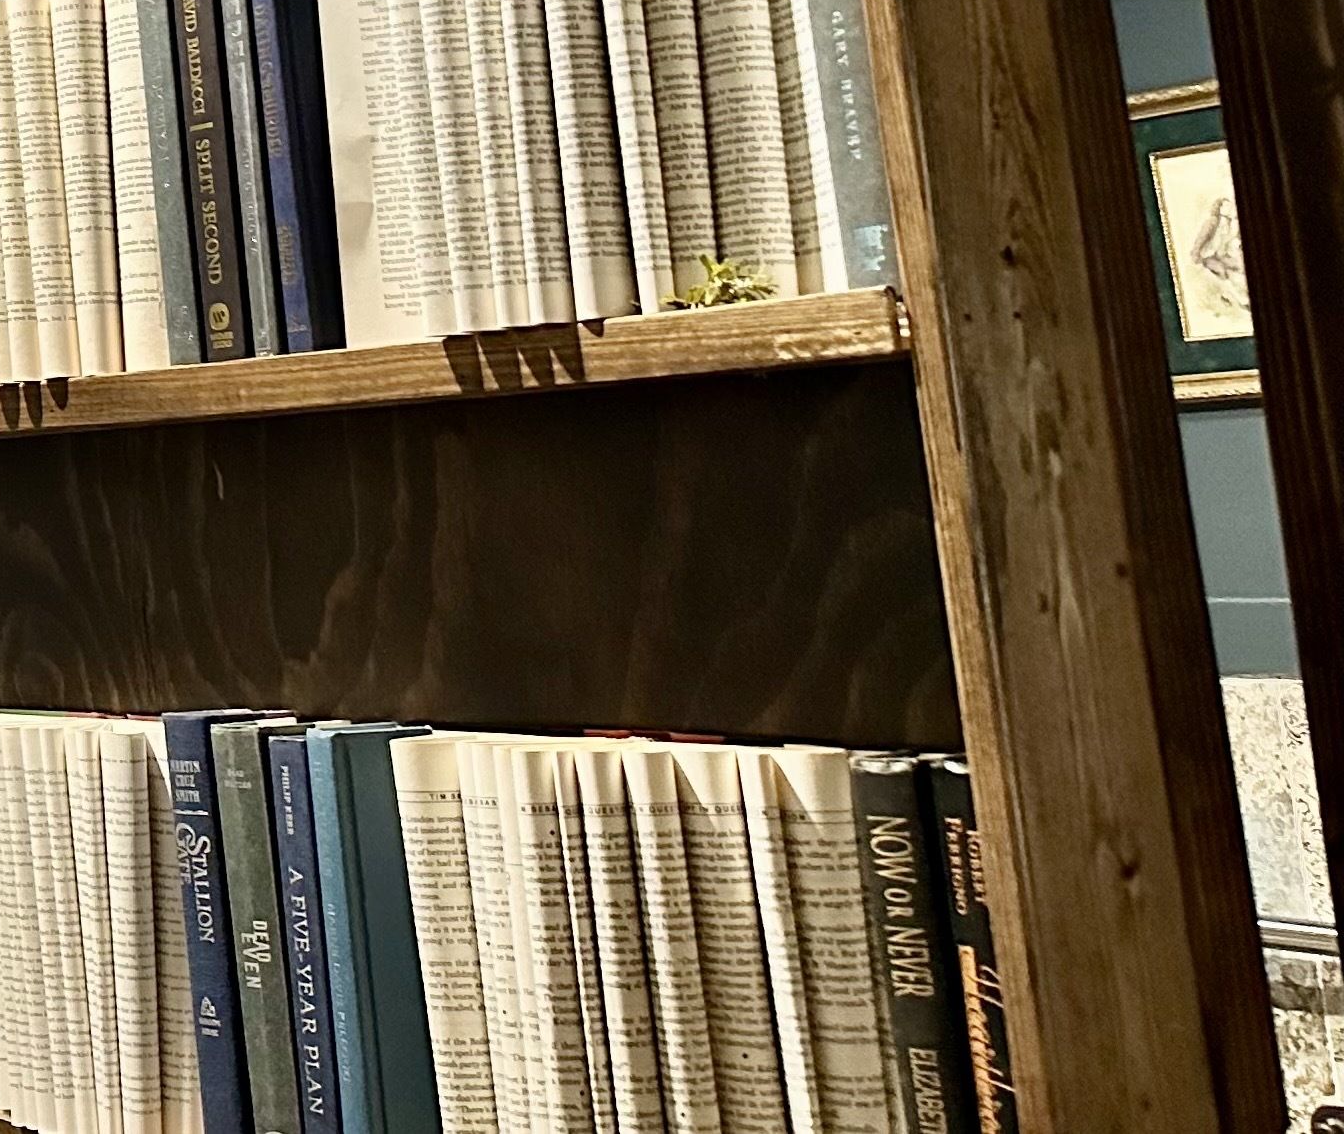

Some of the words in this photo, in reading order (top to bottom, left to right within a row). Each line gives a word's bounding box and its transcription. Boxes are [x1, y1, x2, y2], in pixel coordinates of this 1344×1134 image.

[830, 9, 850, 69] GARY
[185, 36, 206, 117] BALDACCI
[194, 137, 215, 194] SPLIT
[199, 197, 224, 286] SECOND
[280, 764, 292, 807] PHILIP
[174, 821, 196, 885] GATE
[287, 866, 304, 886] A
[866, 814, 918, 885] NOW
[185, 834, 216, 944] STALLION
[883, 886, 915, 918] OR
[240, 932, 262, 991] EVEN
[252, 919, 272, 964] DEAD
[290, 894, 318, 1035] FIVE-YEAR
[885, 923, 936, 999] NEVER
[302, 1044, 325, 1116] PLAN
[908, 1047, 949, 1134] ELIZABET
